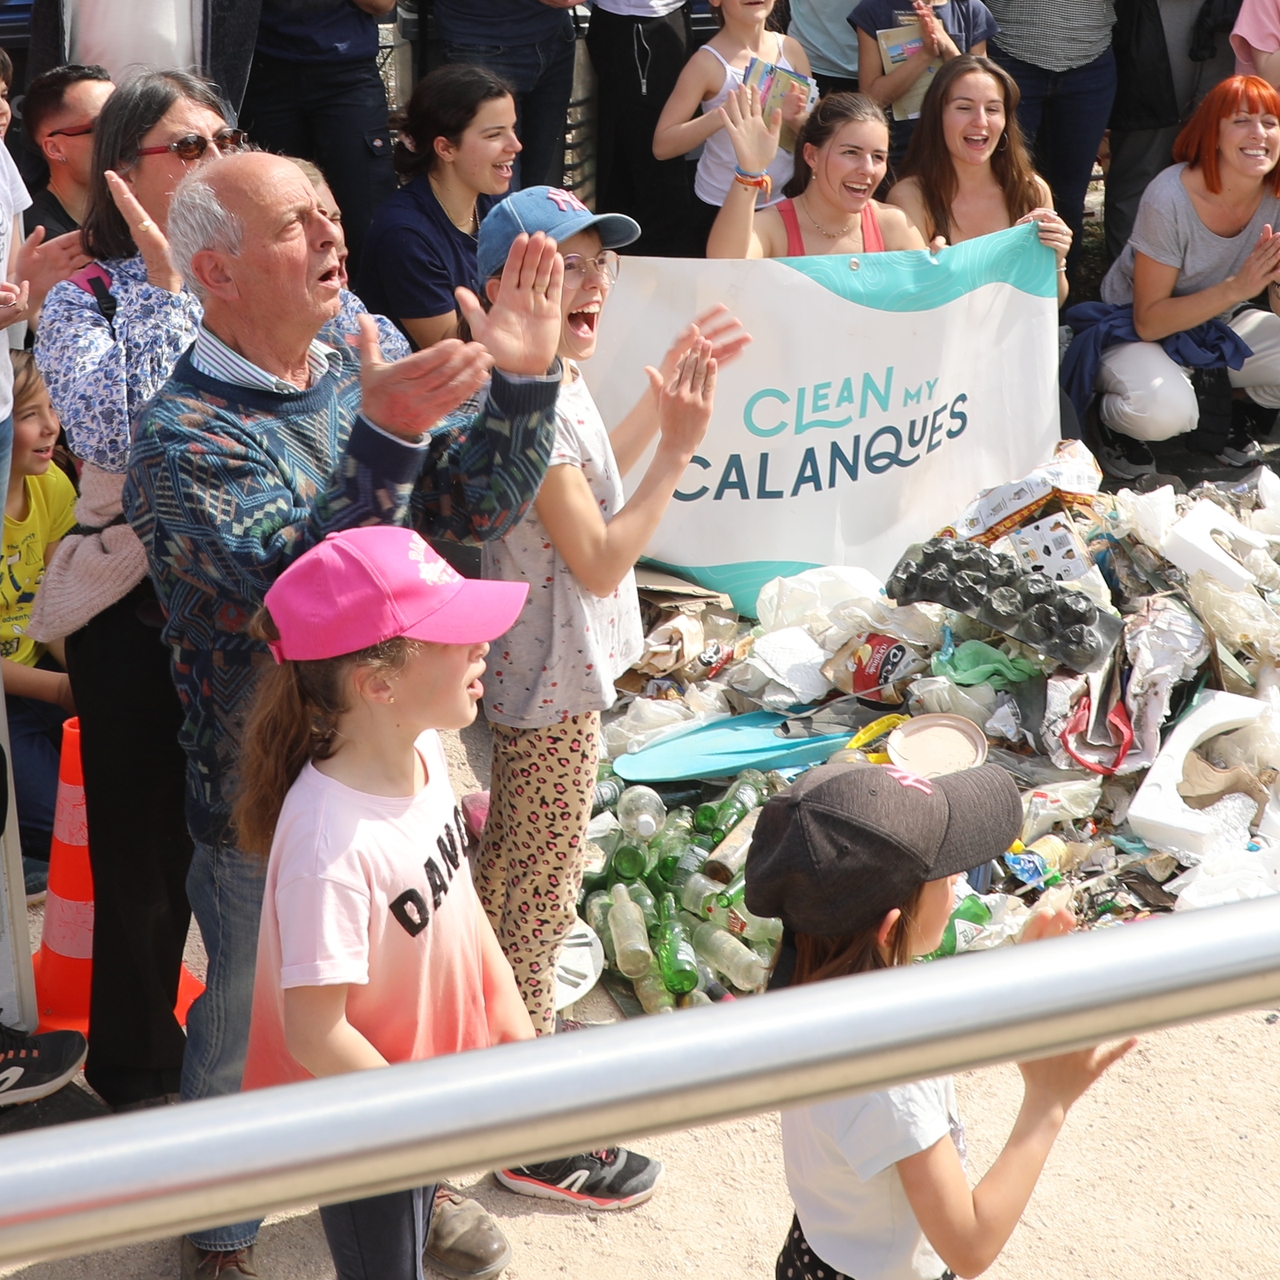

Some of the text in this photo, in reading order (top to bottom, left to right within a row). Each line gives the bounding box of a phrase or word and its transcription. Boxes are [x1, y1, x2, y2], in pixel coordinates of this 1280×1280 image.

[743, 366, 939, 438] CLEAN MY
[672, 393, 968, 502] CALANQUES
